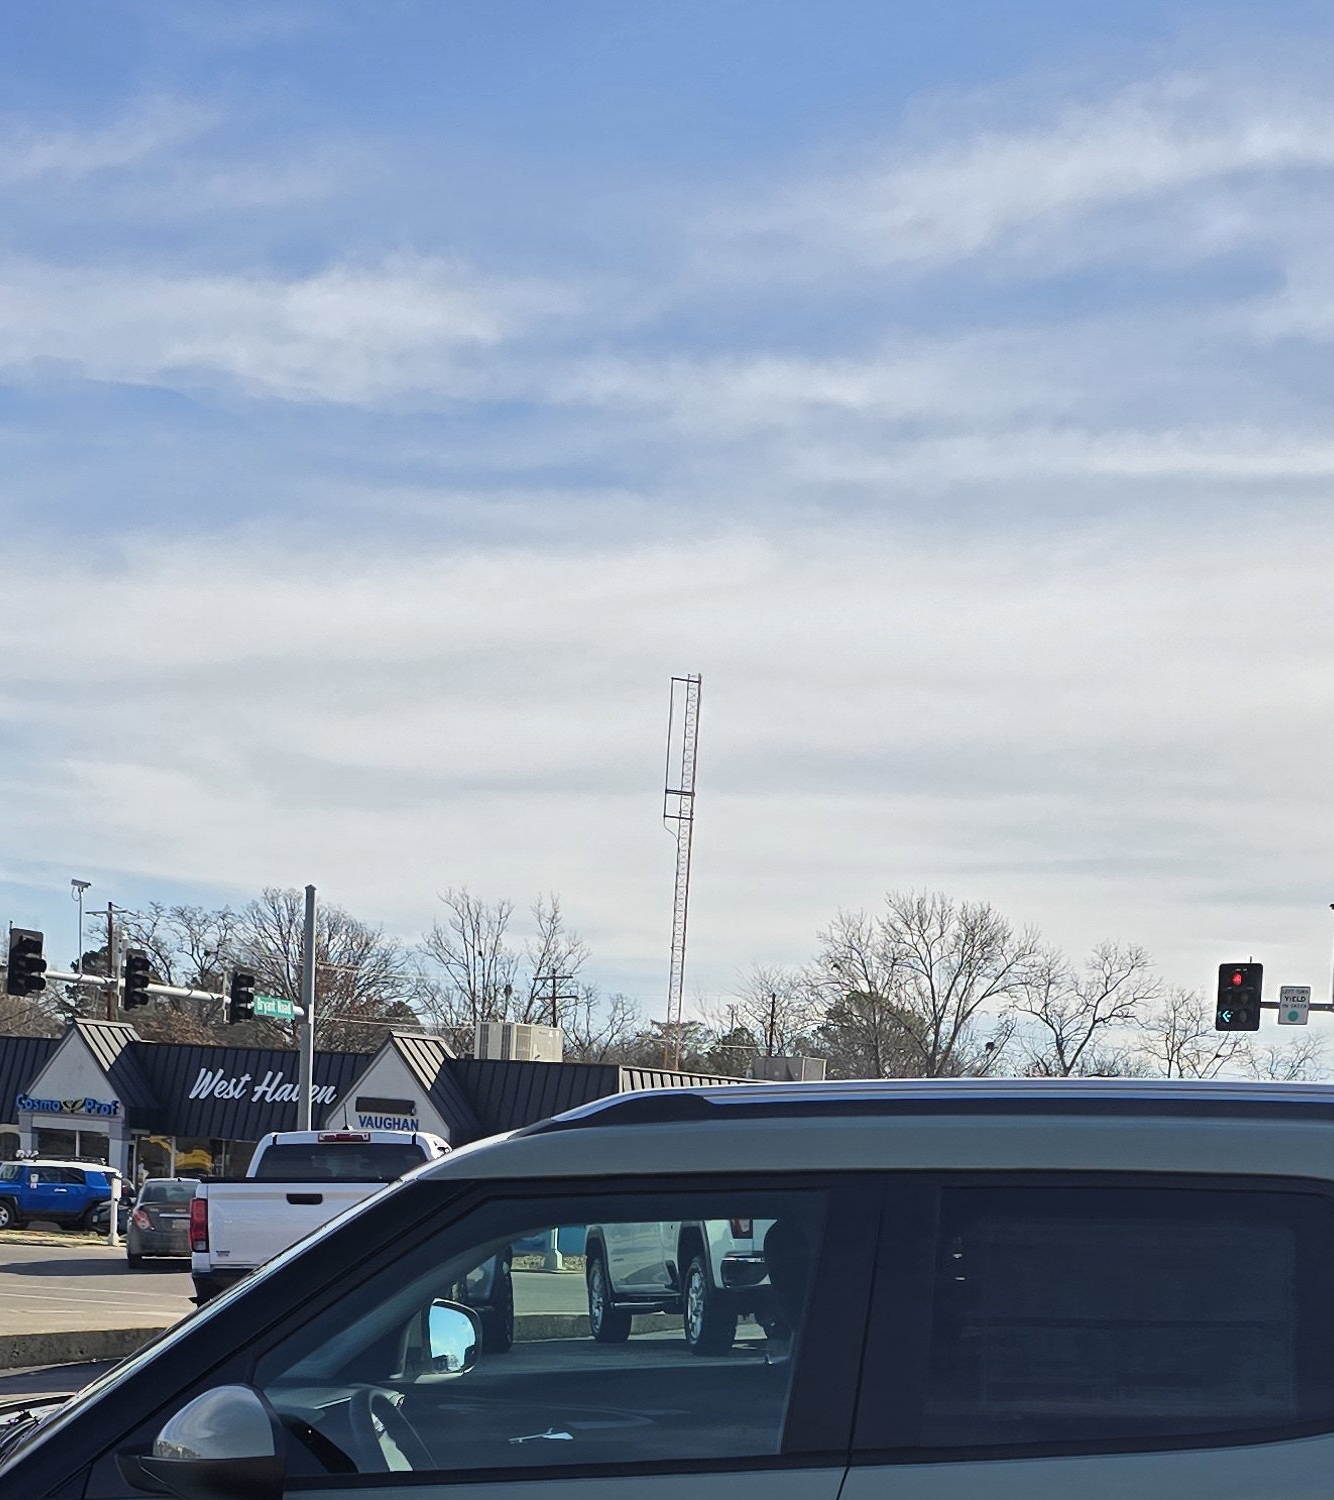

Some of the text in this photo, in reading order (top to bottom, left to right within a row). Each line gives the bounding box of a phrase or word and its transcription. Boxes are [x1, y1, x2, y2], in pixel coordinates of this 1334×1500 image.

[188, 1067, 251, 1100] West
[15, 1093, 120, 1115] Cosmo Prof
[358, 1115, 420, 1131] VAUGHAN
